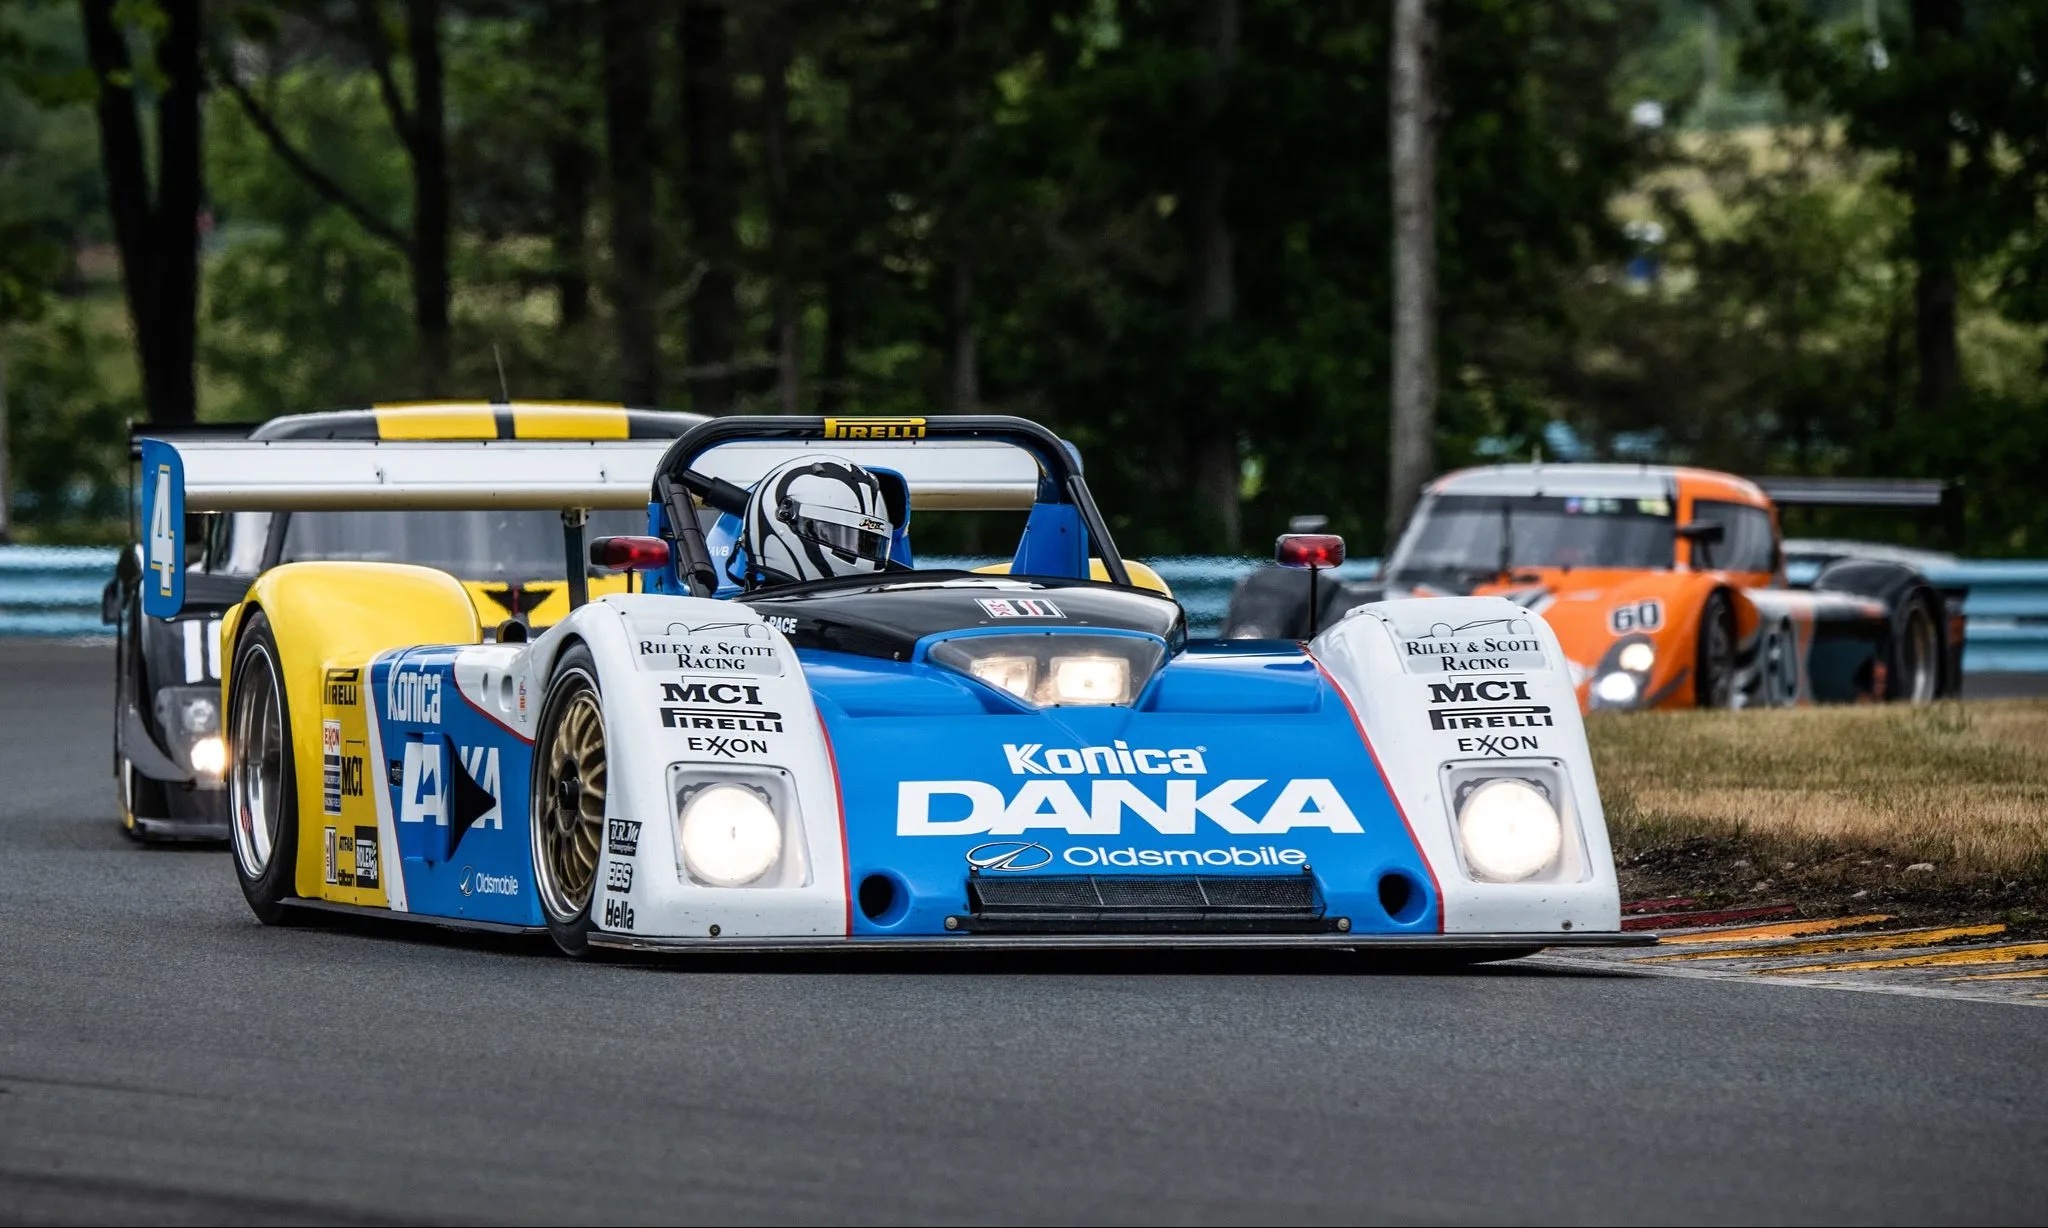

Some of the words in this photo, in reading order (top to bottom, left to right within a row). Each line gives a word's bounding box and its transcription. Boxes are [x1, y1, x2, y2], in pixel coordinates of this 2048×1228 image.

[824, 417, 927, 438] PIRELLI
[151, 464, 175, 597] 4
[1610, 601, 1661, 632] 60
[700, 645, 711, 655] &
[718, 642, 774, 657] SCOTT
[1406, 641, 1460, 655] RILEY
[1467, 642, 1479, 653] &
[1484, 637, 1540, 651] SCOTT
[678, 653, 745, 670] RACING
[1442, 656, 1509, 671] RACING
[324, 668, 359, 705] PIRELLI
[660, 683, 762, 705] MCI
[1428, 681, 1530, 703] MCI
[660, 707, 783, 733] PIRELLI
[1428, 705, 1553, 730] PIRELLI
[688, 735, 768, 758] EXXON
[1002, 740, 1207, 775] Konica
[1458, 734, 1539, 757] EXXON
[341, 756, 363, 796] MCI
[897, 779, 1365, 836] DANKA
[1063, 846, 1307, 866] Oldsmobile
[476, 872, 519, 896] Oldsmobile
[607, 862, 633, 893] BBS
[605, 899, 634, 929] Hella
